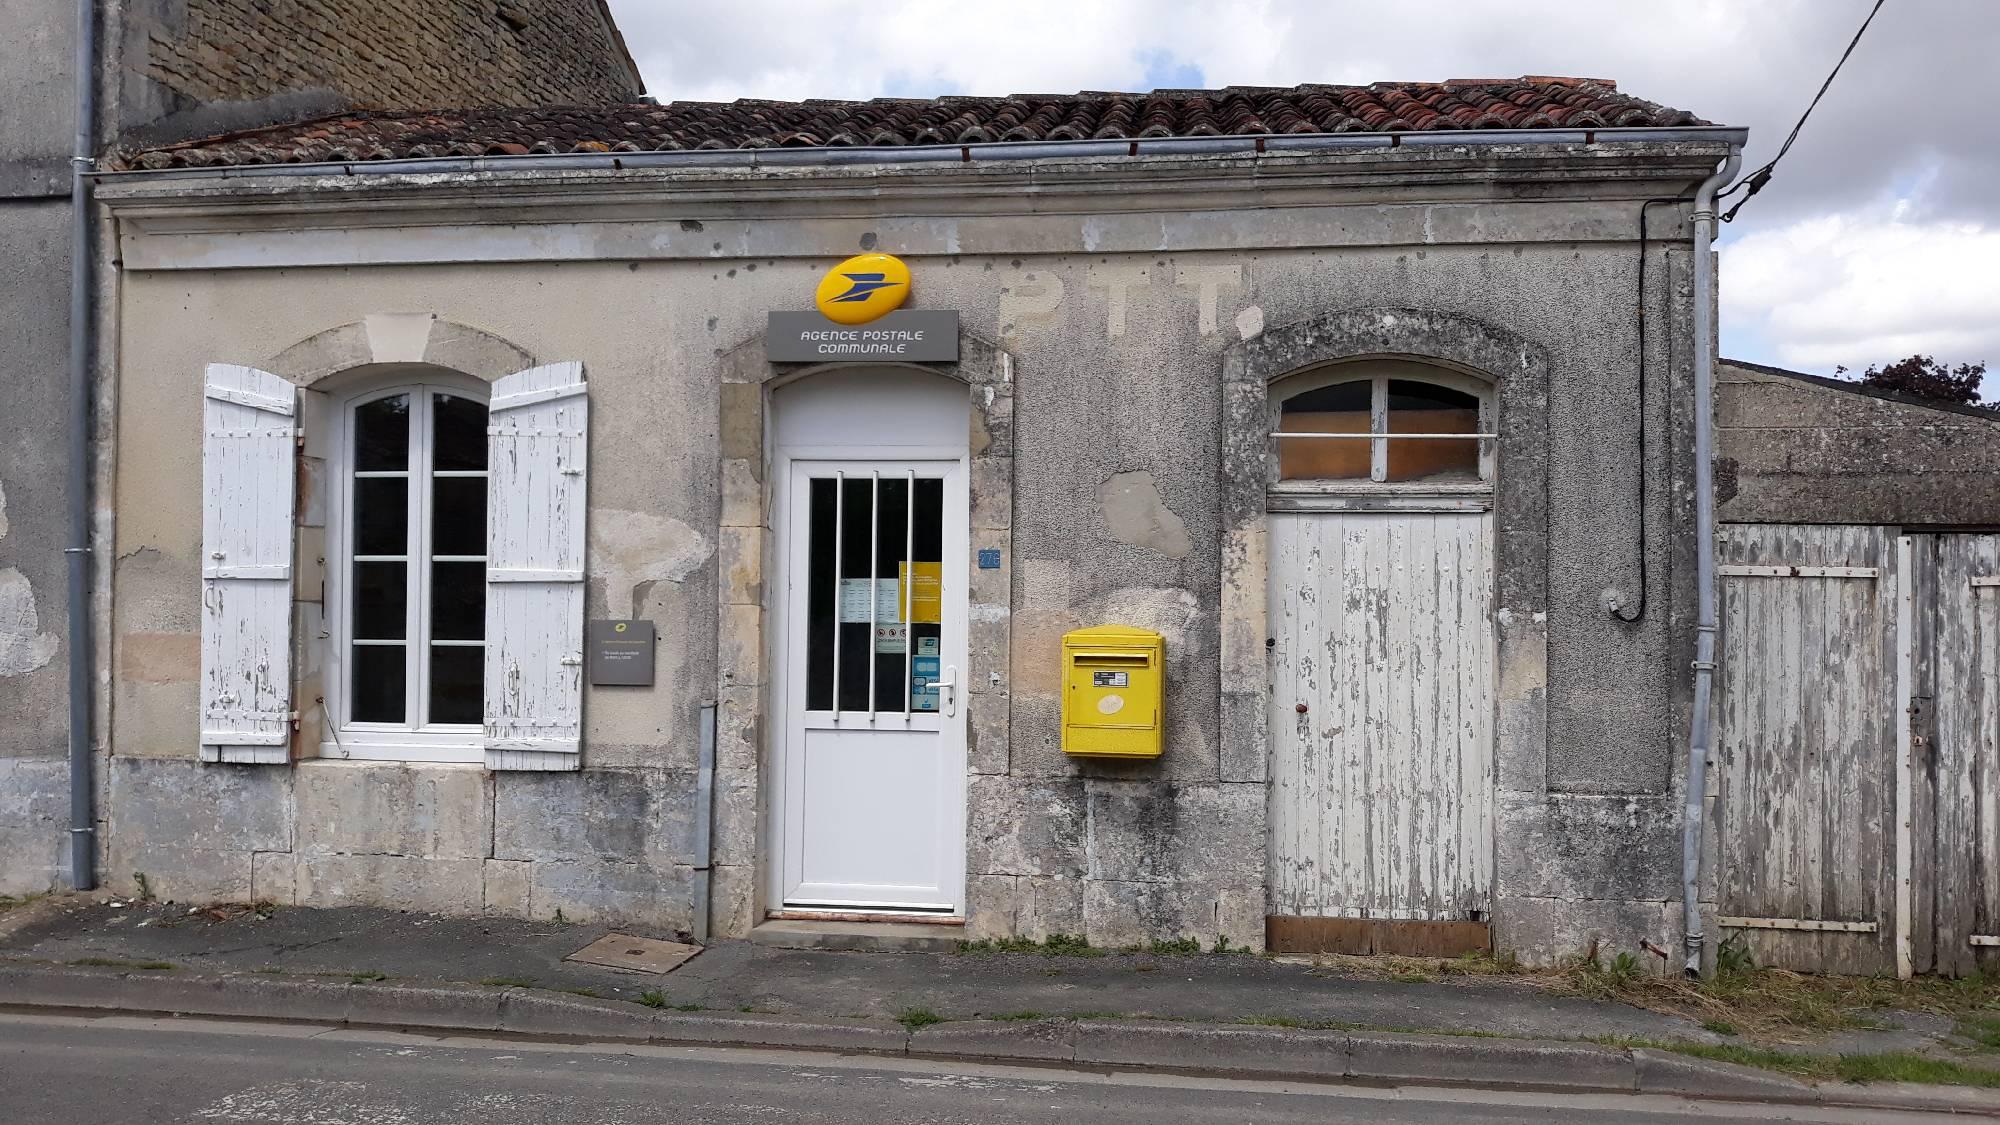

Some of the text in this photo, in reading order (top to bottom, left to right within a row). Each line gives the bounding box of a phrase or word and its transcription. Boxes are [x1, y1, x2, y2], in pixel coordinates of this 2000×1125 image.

[800, 330, 924, 341] AGENCE POSTALE
[818, 343, 906, 354] COMMUNALE
